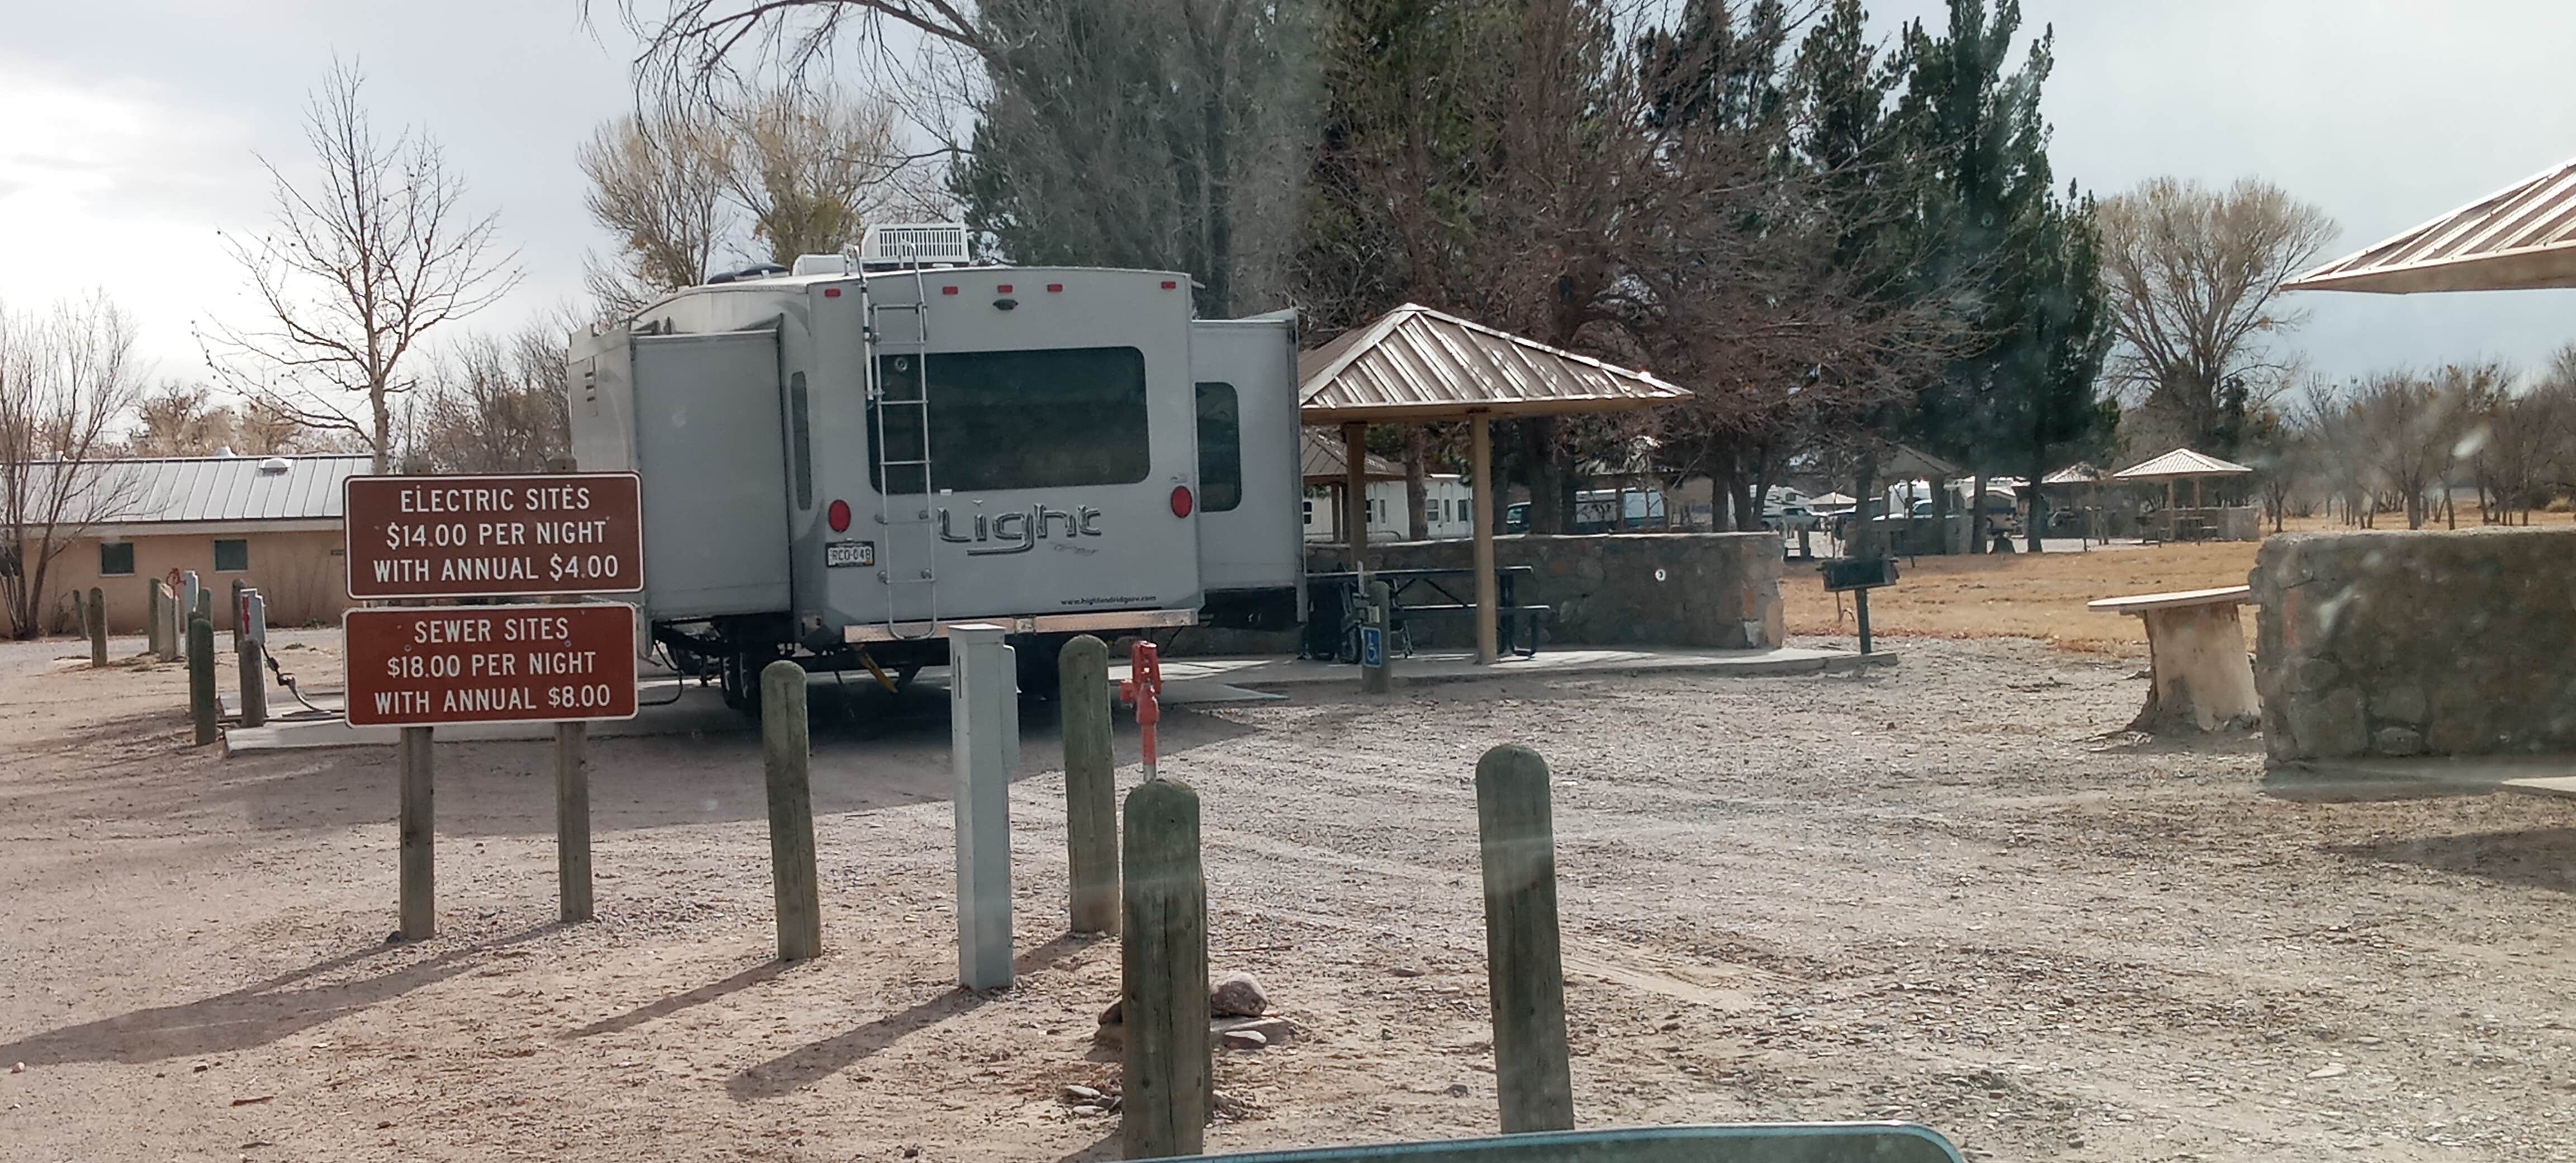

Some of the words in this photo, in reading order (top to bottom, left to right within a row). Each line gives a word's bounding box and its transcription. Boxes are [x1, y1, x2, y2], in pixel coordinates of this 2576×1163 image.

[401, 489, 514, 512] ELECTRIC
[525, 487, 590, 510] SITES
[386, 522, 466, 550] $14.00
[479, 523, 525, 545] PER
[536, 521, 606, 544] NIGHT
[937, 500, 1102, 556] Light
[373, 559, 429, 583] WITH
[441, 557, 539, 581] ANNUAL
[550, 553, 618, 582] $4.00
[414, 619, 491, 644] SEWER
[504, 617, 568, 641] SITES
[387, 655, 460, 678] $18.00
[472, 654, 515, 676] PER
[529, 651, 596, 675] NIGHT
[375, 691, 429, 715] WITH
[443, 687, 537, 712] ANNUAL
[548, 684, 610, 708] $8.00
